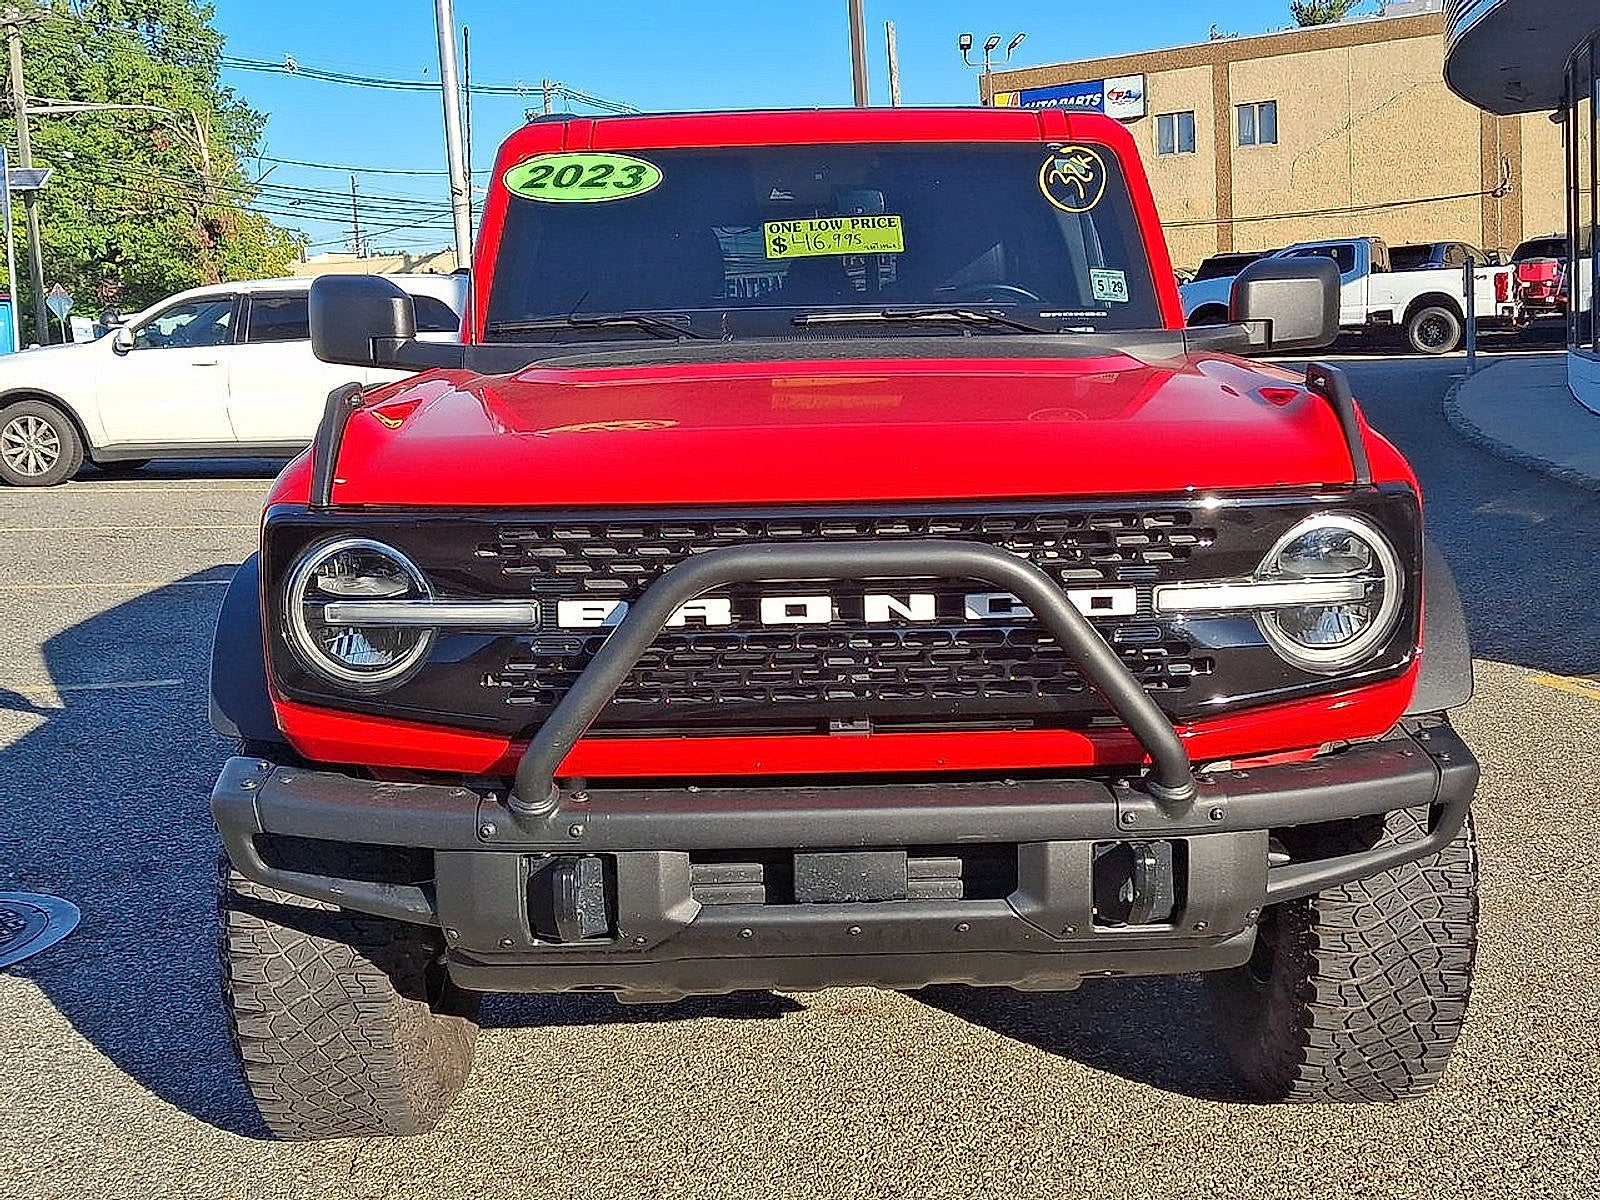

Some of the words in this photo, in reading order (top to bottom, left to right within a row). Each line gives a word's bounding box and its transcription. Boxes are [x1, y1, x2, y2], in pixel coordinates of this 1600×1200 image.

[519, 164, 648, 190] 2023
[769, 222, 802, 234] ONE
[809, 219, 843, 231] LOW
[851, 217, 897, 229] PRICE
[1097, 280, 1105, 292] 5
[1111, 281, 1124, 293] 29
[557, 588, 1137, 628] BRONCO
